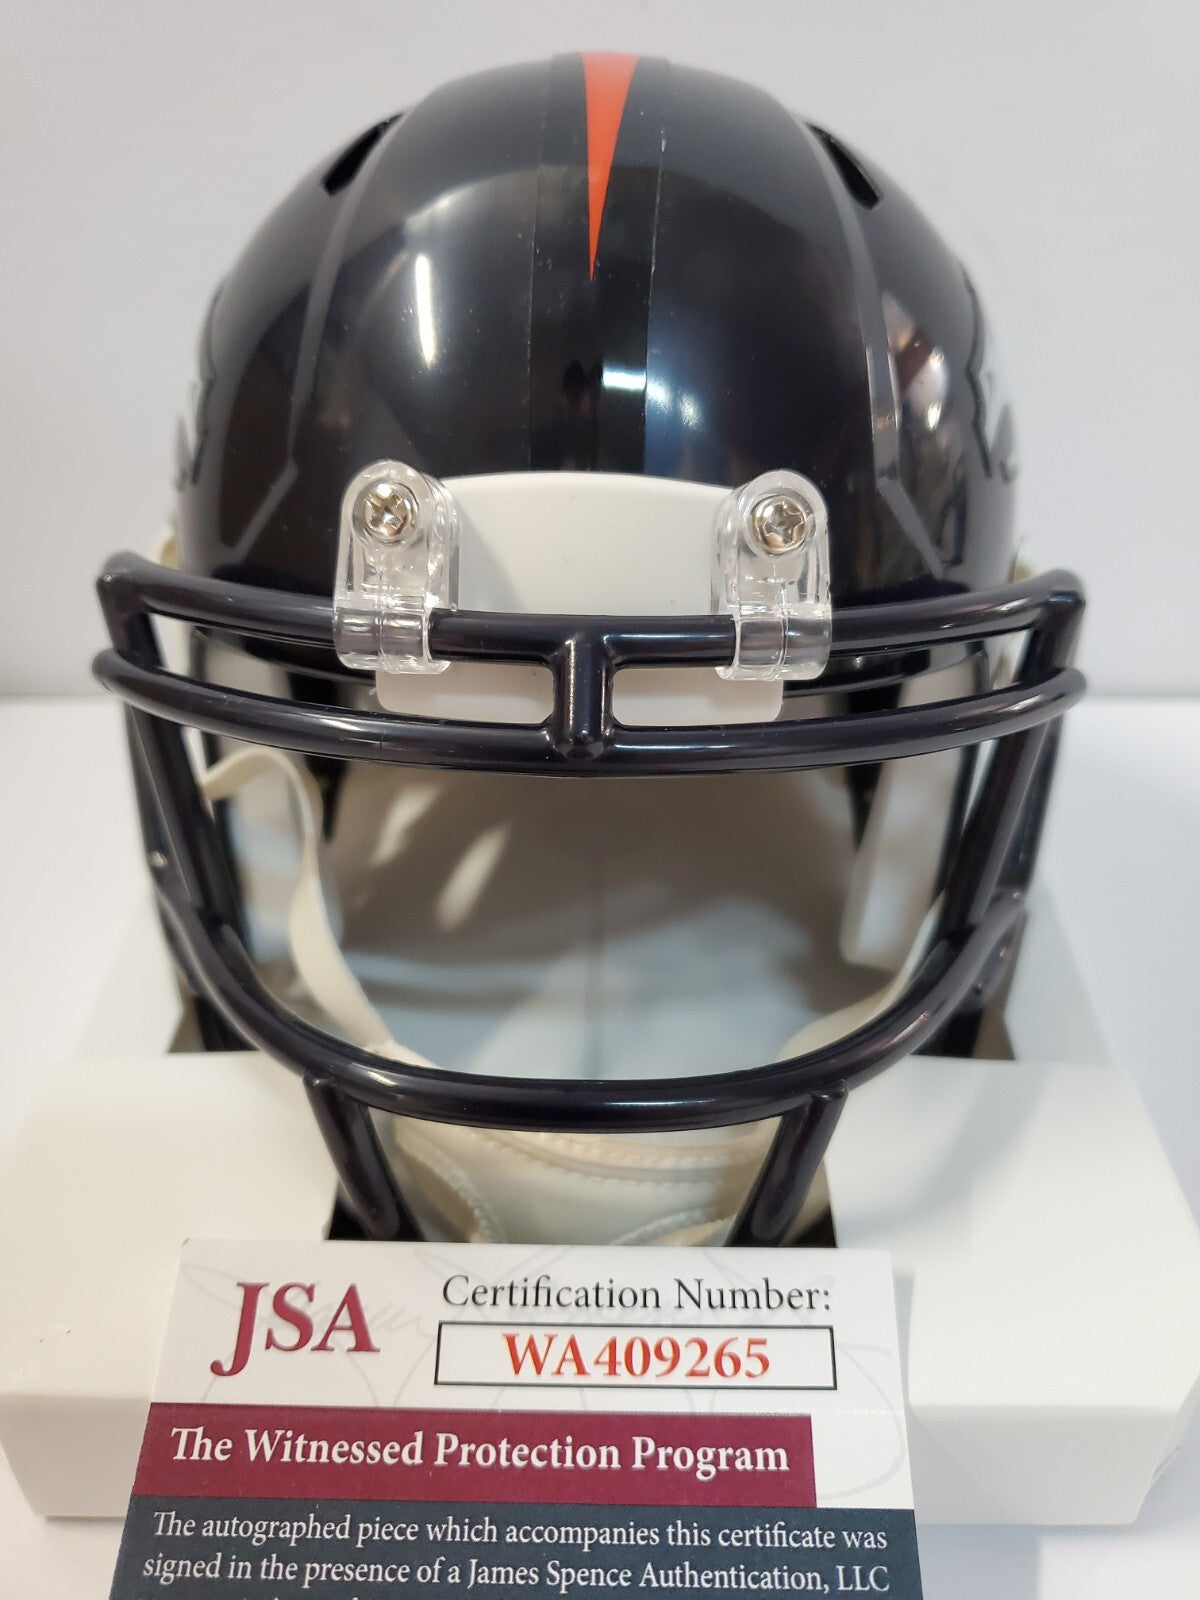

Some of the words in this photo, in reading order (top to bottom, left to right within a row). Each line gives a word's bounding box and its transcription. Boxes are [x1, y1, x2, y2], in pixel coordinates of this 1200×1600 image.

[442, 1275, 664, 1310] Certification
[675, 1278, 831, 1311] Number:
[210, 1282, 380, 1377] JSA
[503, 1333, 770, 1379] WA409265
[171, 1426, 234, 1463] The
[244, 1428, 423, 1467] Witnessed
[435, 1433, 619, 1470] Protection
[632, 1436, 790, 1480] Program
[154, 1511, 195, 1537] The
[202, 1513, 350, 1546] autographed
[356, 1516, 418, 1547] piece
[426, 1515, 497, 1542] which
[505, 1521, 660, 1551] accompanies
[666, 1520, 711, 1546] this
[718, 1522, 835, 1548] certificate
[842, 1531, 888, 1549] was
[143, 1553, 222, 1585] signed
[228, 1555, 252, 1579] in
[259, 1554, 298, 1580] the
[302, 1564, 410, 1588] presence
[416, 1557, 446, 1583] of
[447, 1567, 461, 1583] a
[466, 1559, 539, 1589] James
[546, 1561, 632, 1594] Spence
[638, 1561, 829, 1594] Authentication,
[836, 1565, 890, 1592] LLC
